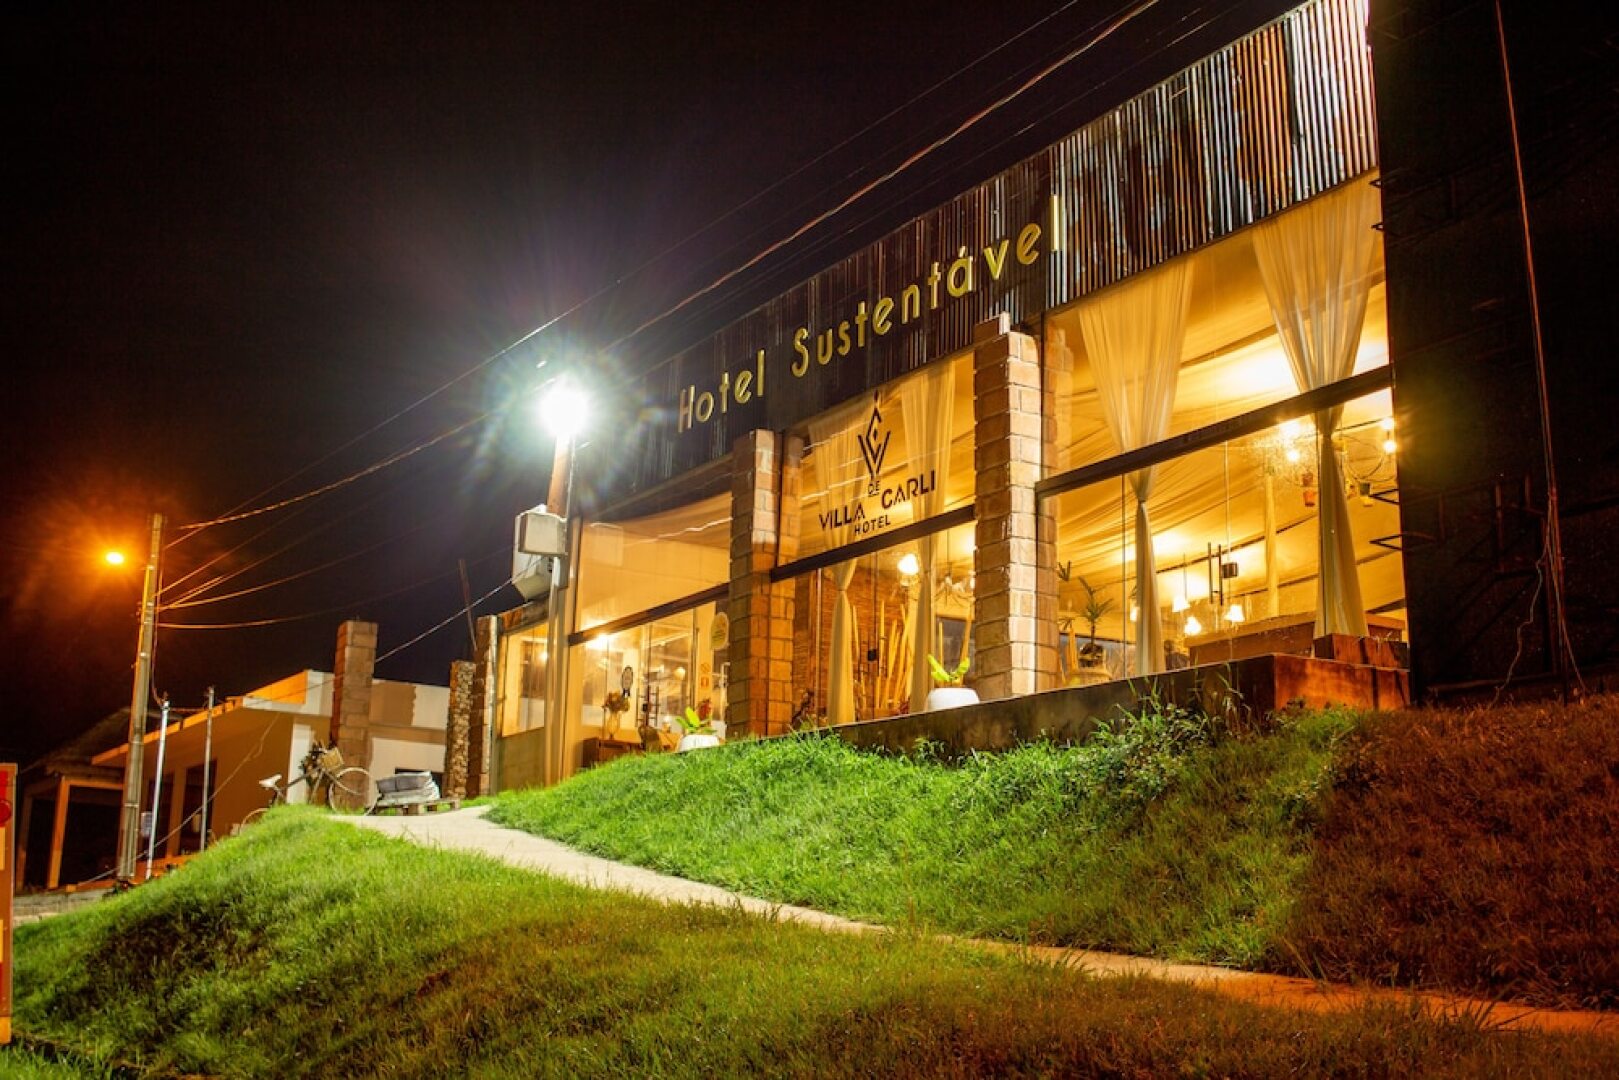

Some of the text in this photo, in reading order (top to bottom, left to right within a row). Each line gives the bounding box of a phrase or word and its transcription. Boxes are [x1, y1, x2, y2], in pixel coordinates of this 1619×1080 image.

[677, 194, 1060, 433] Hotel Sustentável
[818, 470, 935, 530] VILLA DE CARLI
[854, 515, 891, 535] HOTEL
